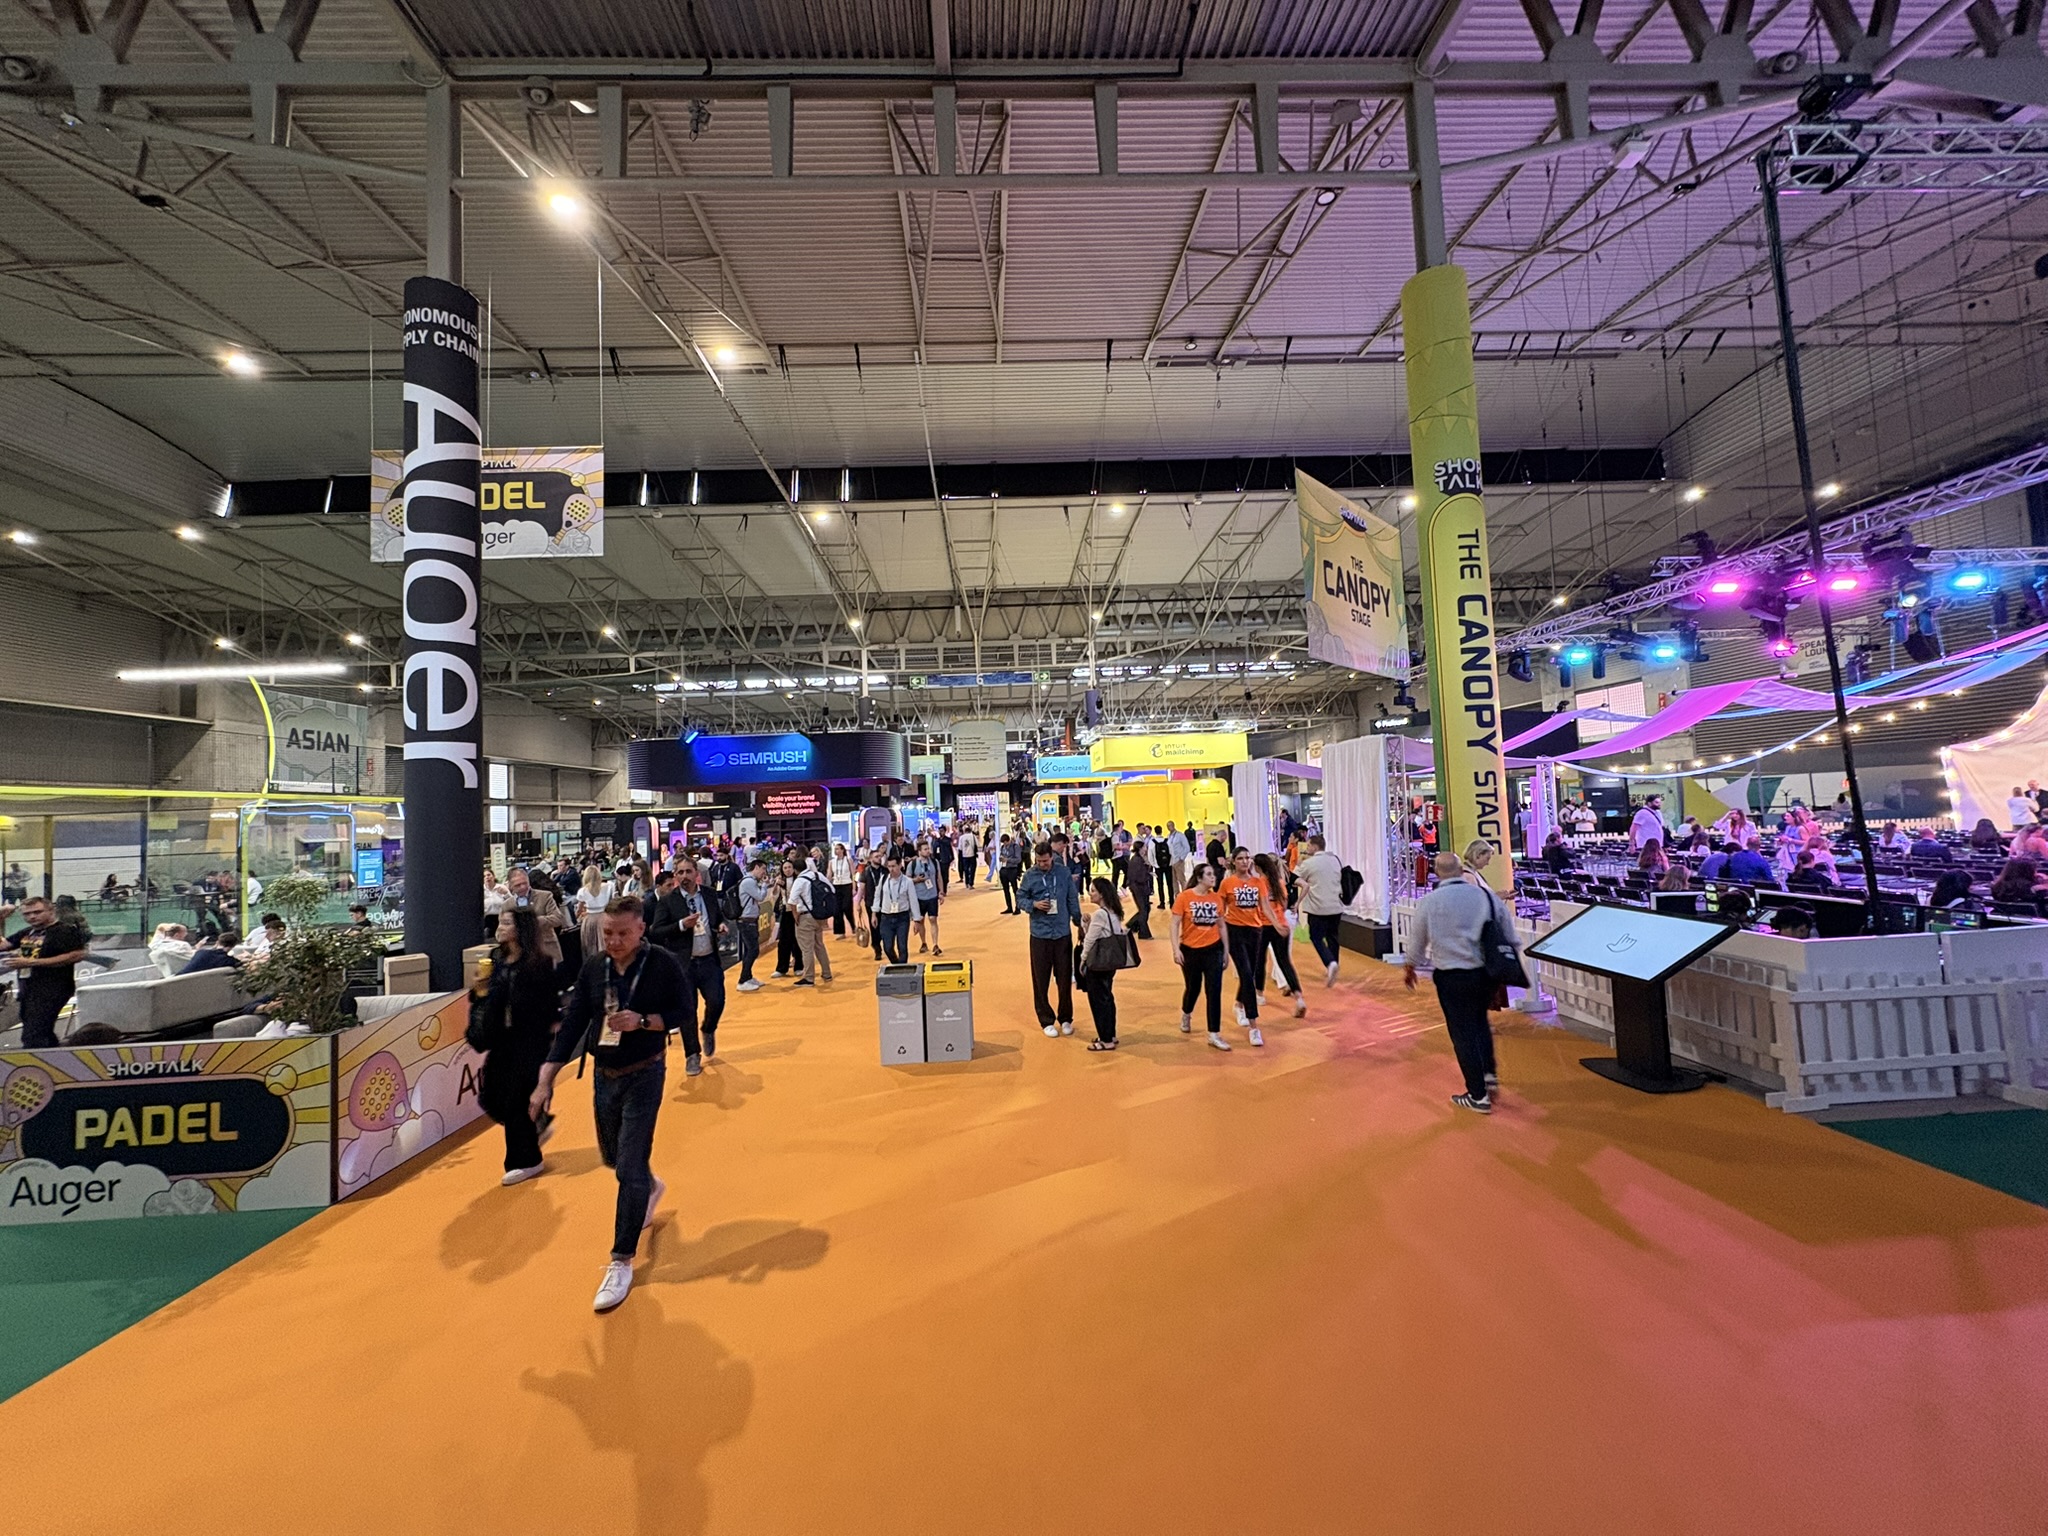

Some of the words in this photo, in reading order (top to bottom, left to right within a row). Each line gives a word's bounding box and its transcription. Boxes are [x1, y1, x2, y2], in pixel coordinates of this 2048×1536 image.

[403, 307, 478, 340] ONOMOUS
[481, 460, 518, 469] PTALK
[481, 481, 546, 511] DEL
[481, 532, 516, 550] ger
[1457, 529, 1482, 580] THE
[1350, 555, 1364, 574] THE
[403, 382, 482, 790] Auger
[1322, 559, 1391, 618] CANOPY
[1351, 608, 1372, 628] STAGE
[1799, 635, 1846, 651] SPEAKRS
[1456, 594, 1499, 757] CANOPY
[286, 727, 350, 753] ASIAN
[728, 750, 807, 766] SEMRUSH
[1165, 748, 1205, 756] mailchimp
[1052, 764, 1089, 773] Optimizely
[1233, 886, 1259, 894] SHOP
[1234, 893, 1260, 901] TALK
[1189, 901, 1219, 910] SHOP
[1190, 909, 1219, 917] TALK
[106, 1058, 204, 1078] SHOPTALK
[74, 1101, 240, 1150] PADEL
[9, 1175, 122, 1217] Auger
